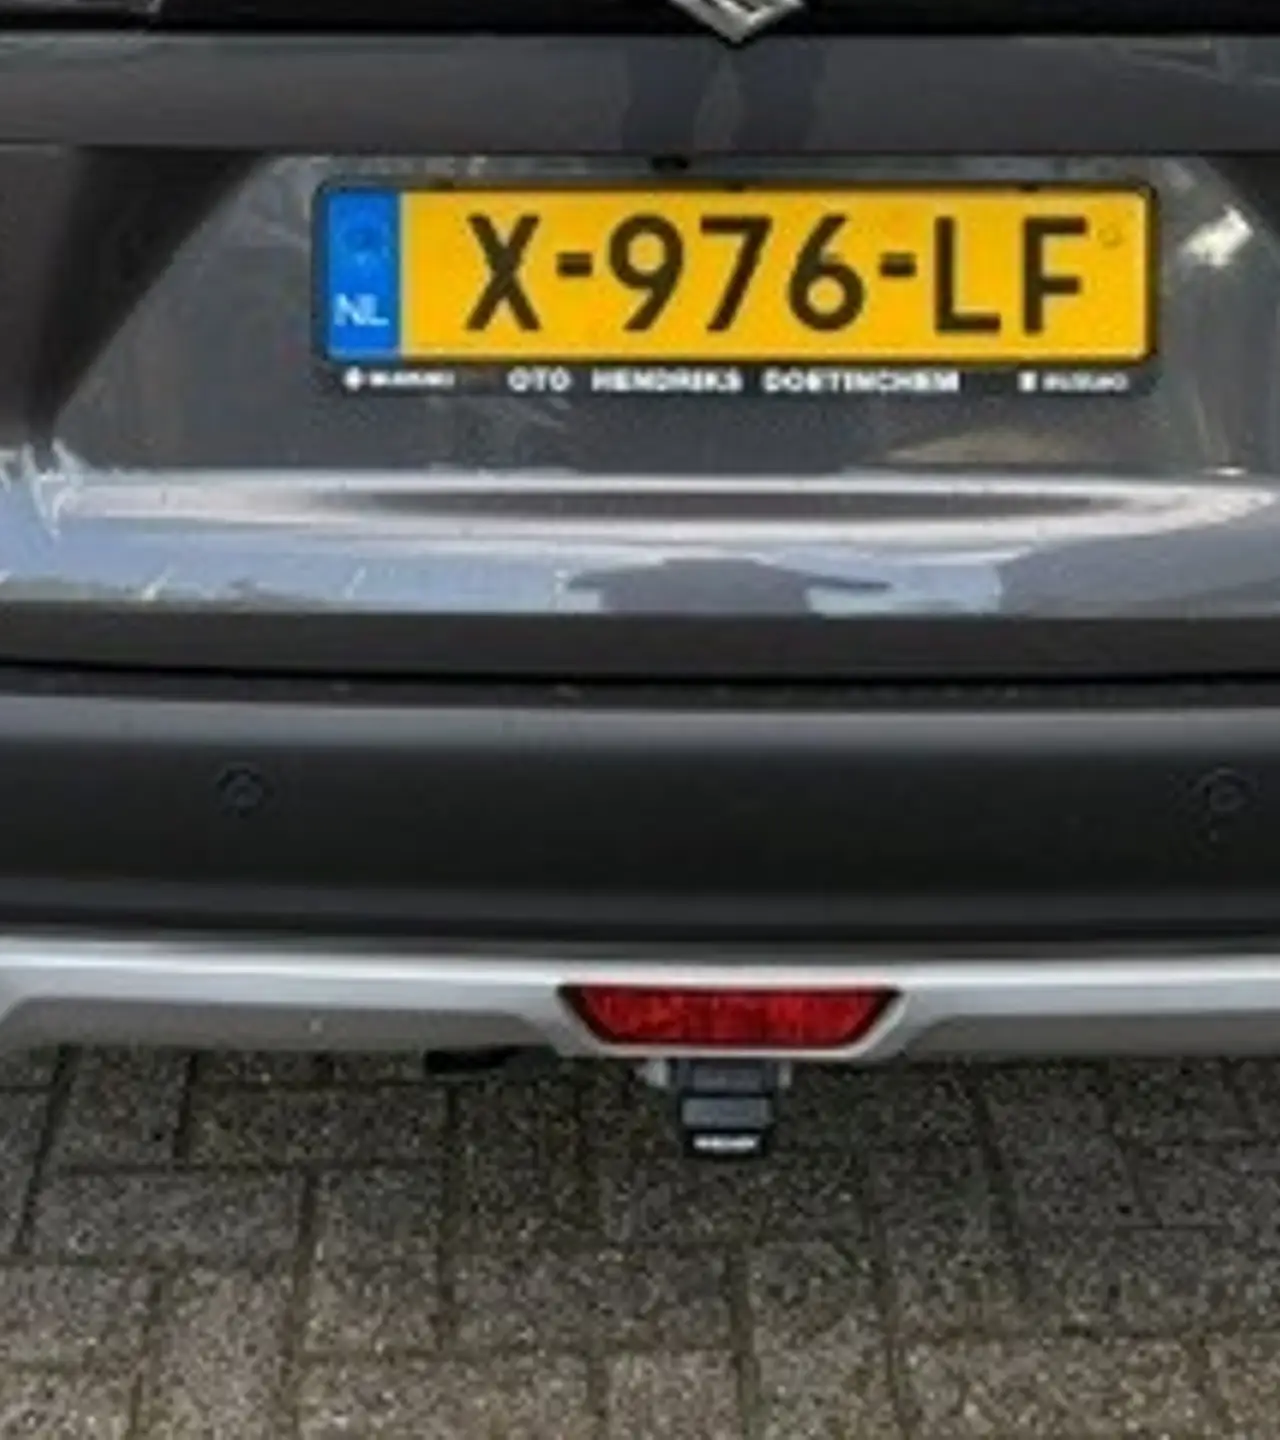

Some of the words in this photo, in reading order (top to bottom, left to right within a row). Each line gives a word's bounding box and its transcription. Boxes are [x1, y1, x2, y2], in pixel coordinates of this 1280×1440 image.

[464, 213, 1090, 333] X-976-LF
[334, 293, 389, 327] NL
[506, 366, 573, 393] OTO
